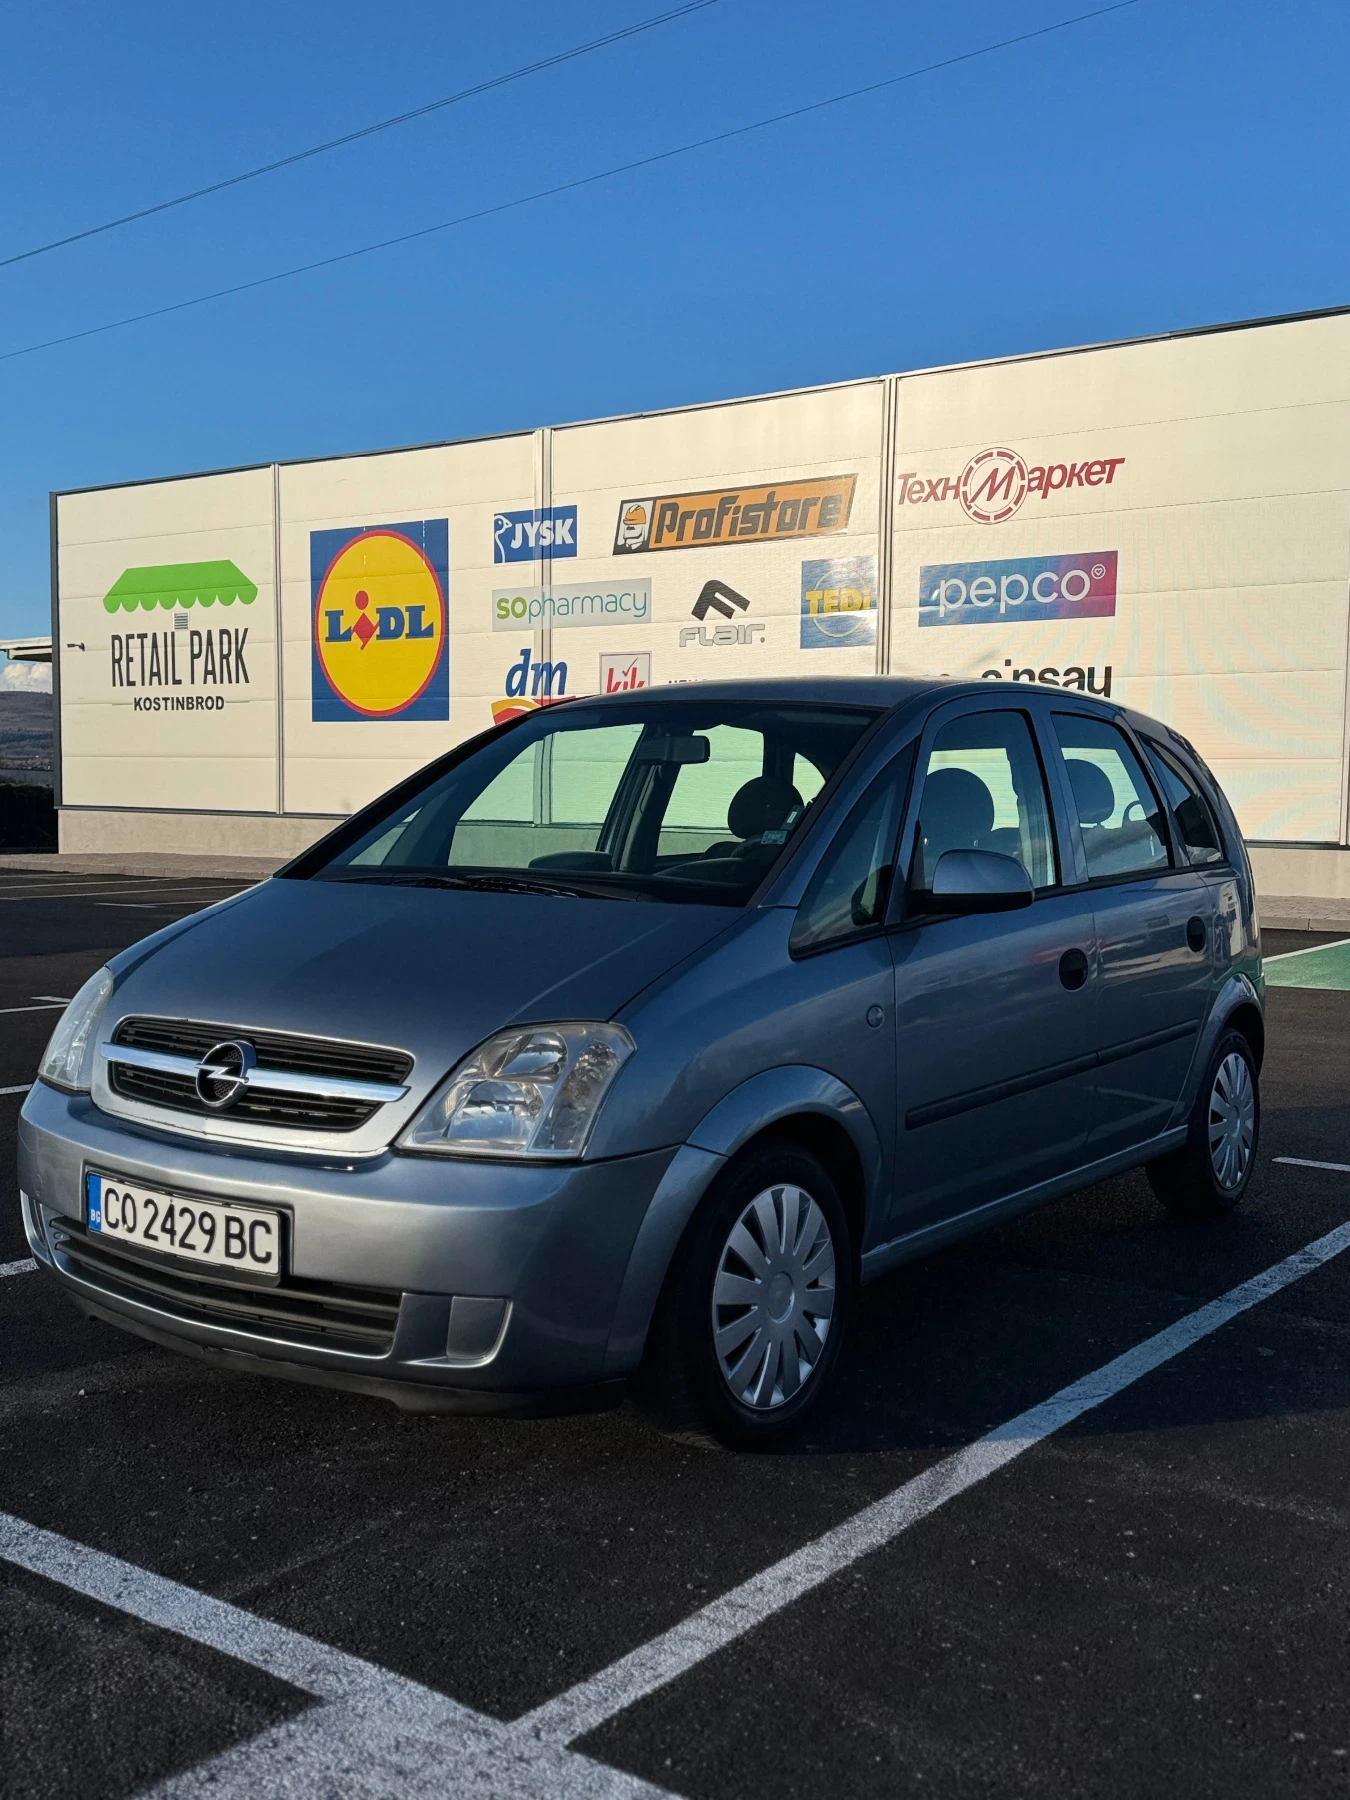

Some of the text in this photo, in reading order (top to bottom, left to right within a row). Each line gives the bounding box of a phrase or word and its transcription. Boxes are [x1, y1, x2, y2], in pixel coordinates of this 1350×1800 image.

[510, 518, 574, 550] JYSK
[655, 490, 843, 544] Profistore
[496, 590, 647, 624] sopharmacy
[939, 569, 1091, 617] pepco
[111, 628, 250, 688] RETAIL PARK
[505, 648, 568, 698] dm
[133, 696, 225, 711] KOSTINBROD
[90, 1208, 101, 1223] BG
[143, 1198, 217, 1254] 2429
[224, 1214, 272, 1264] BC
